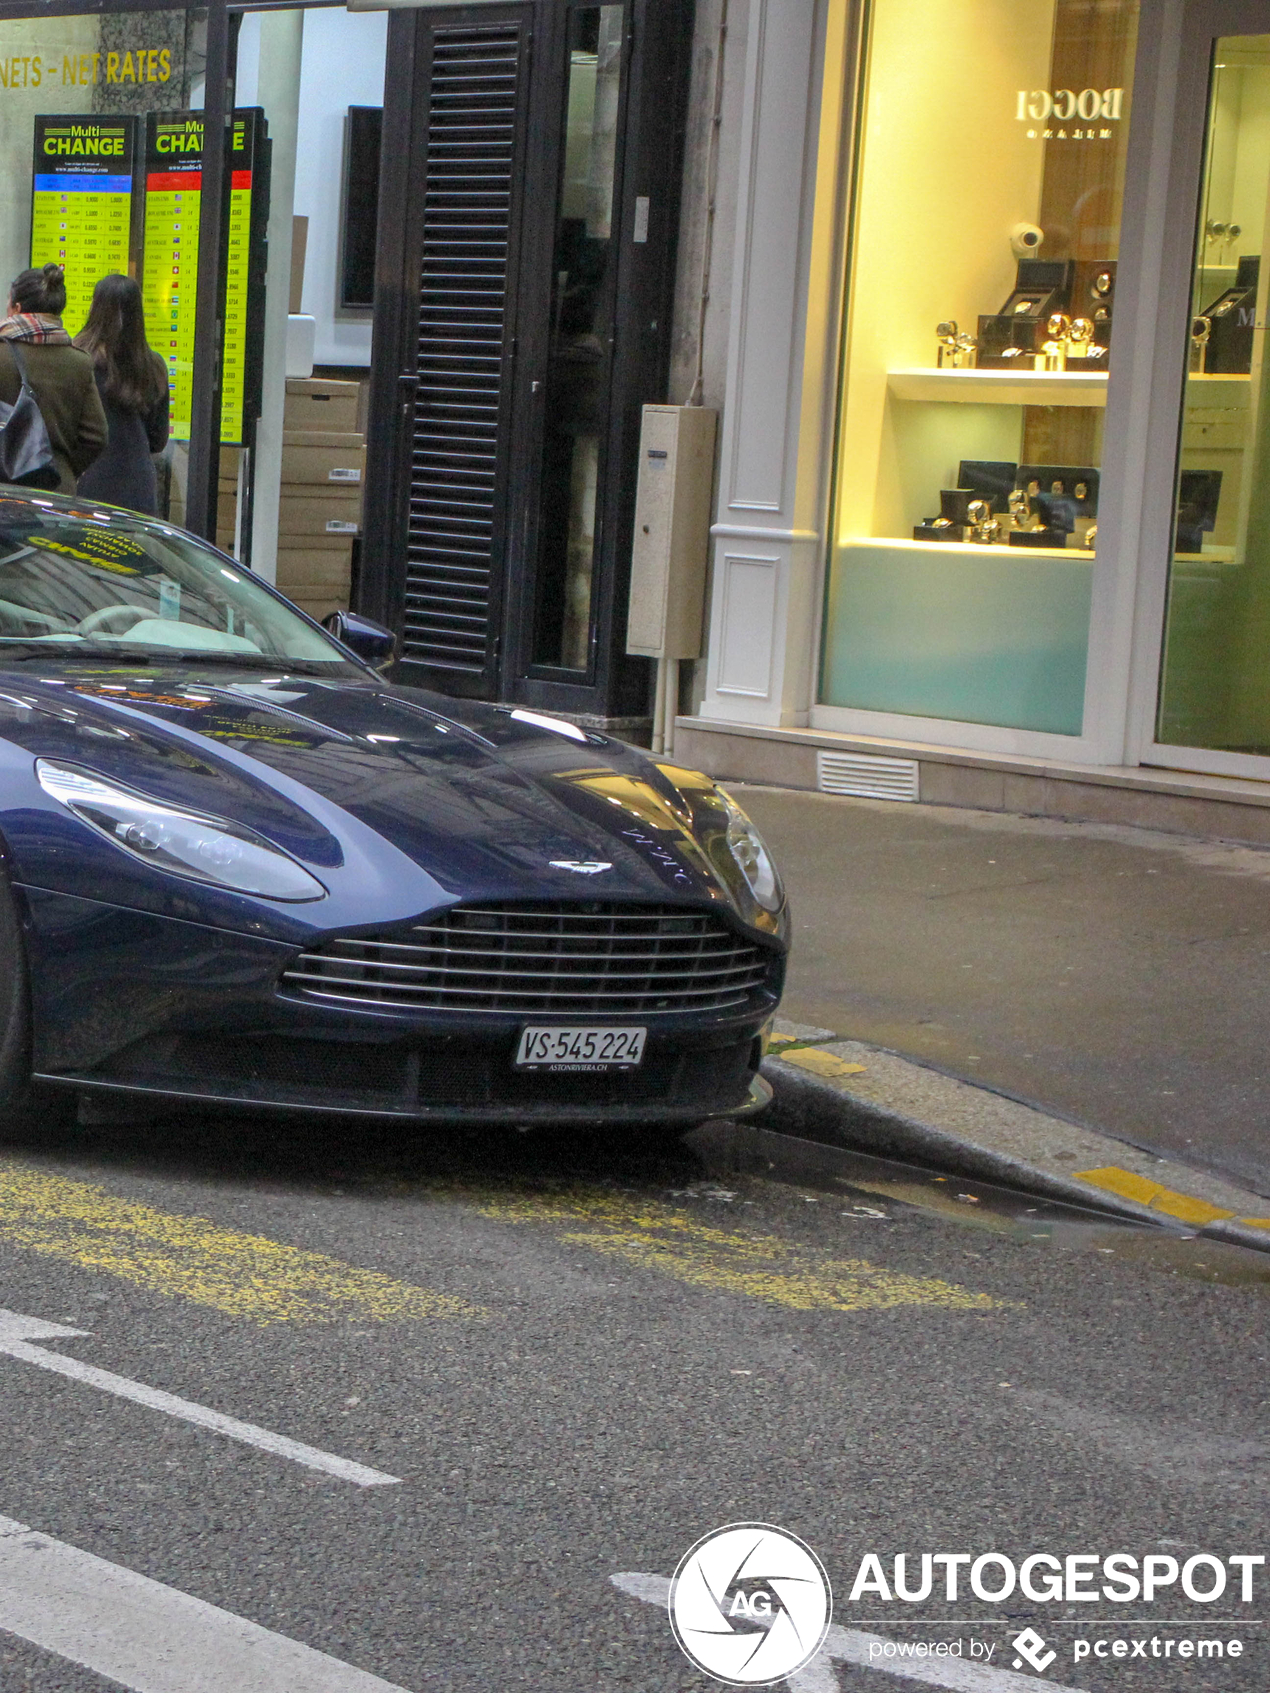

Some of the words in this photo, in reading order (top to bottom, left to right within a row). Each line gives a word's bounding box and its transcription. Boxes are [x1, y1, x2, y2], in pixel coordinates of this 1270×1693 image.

[62, 52, 100, 86] NET
[106, 48, 171, 84] RATES
[71, 125, 100, 137] Multi
[43, 137, 125, 156] CHANGE
